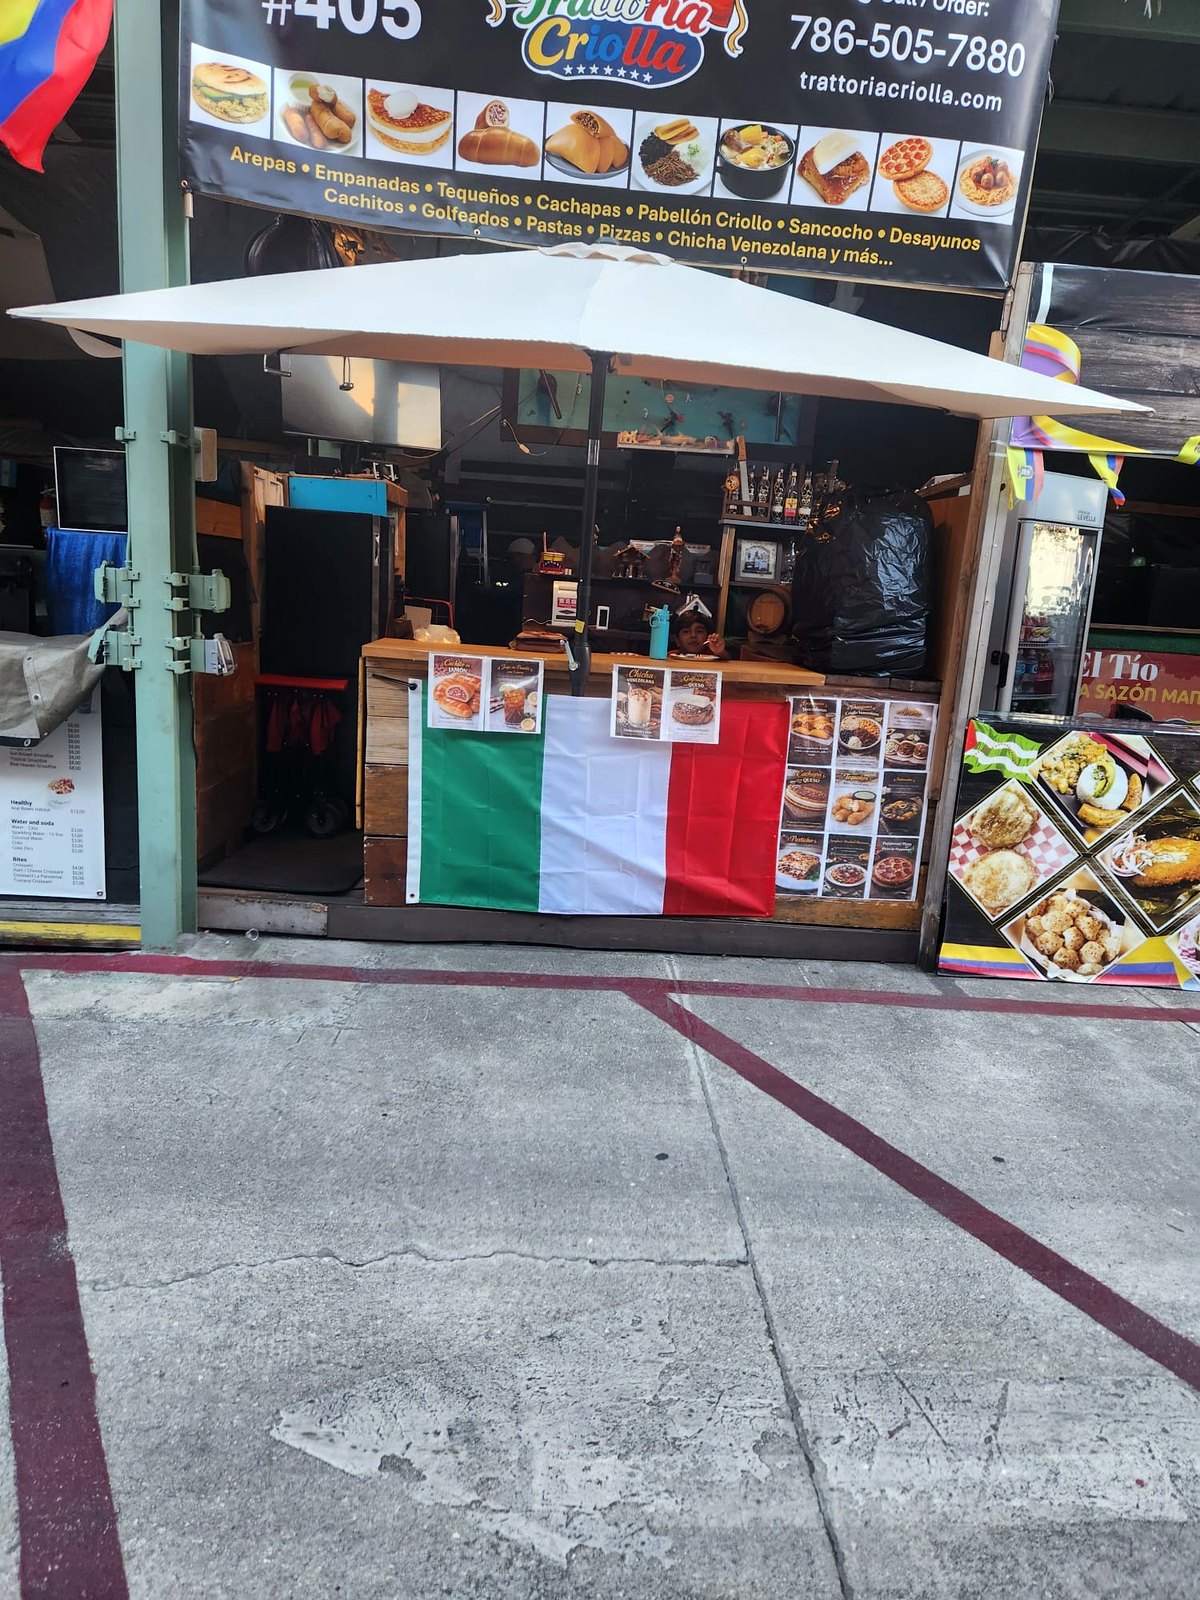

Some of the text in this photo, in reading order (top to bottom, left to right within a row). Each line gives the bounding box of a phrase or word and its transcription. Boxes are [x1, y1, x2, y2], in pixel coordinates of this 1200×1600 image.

[528, 17, 686, 72] Criolla
[790, 14, 1026, 77] 786-505-7880
[800, 71, 1003, 112] trattoriacriolla.com
[231, 146, 981, 251] Arepas Empanadas Tequeños Cachapas Pabellón Criollo Sancocho Desayunos
[325, 187, 893, 267] Cachitos Golfeados Pastas Pizzas Chicha Venezolana y más...
[628, 668, 655, 679] Chicha
[1110, 654, 1158, 681] Tío
[10, 799, 33, 807] Healthy
